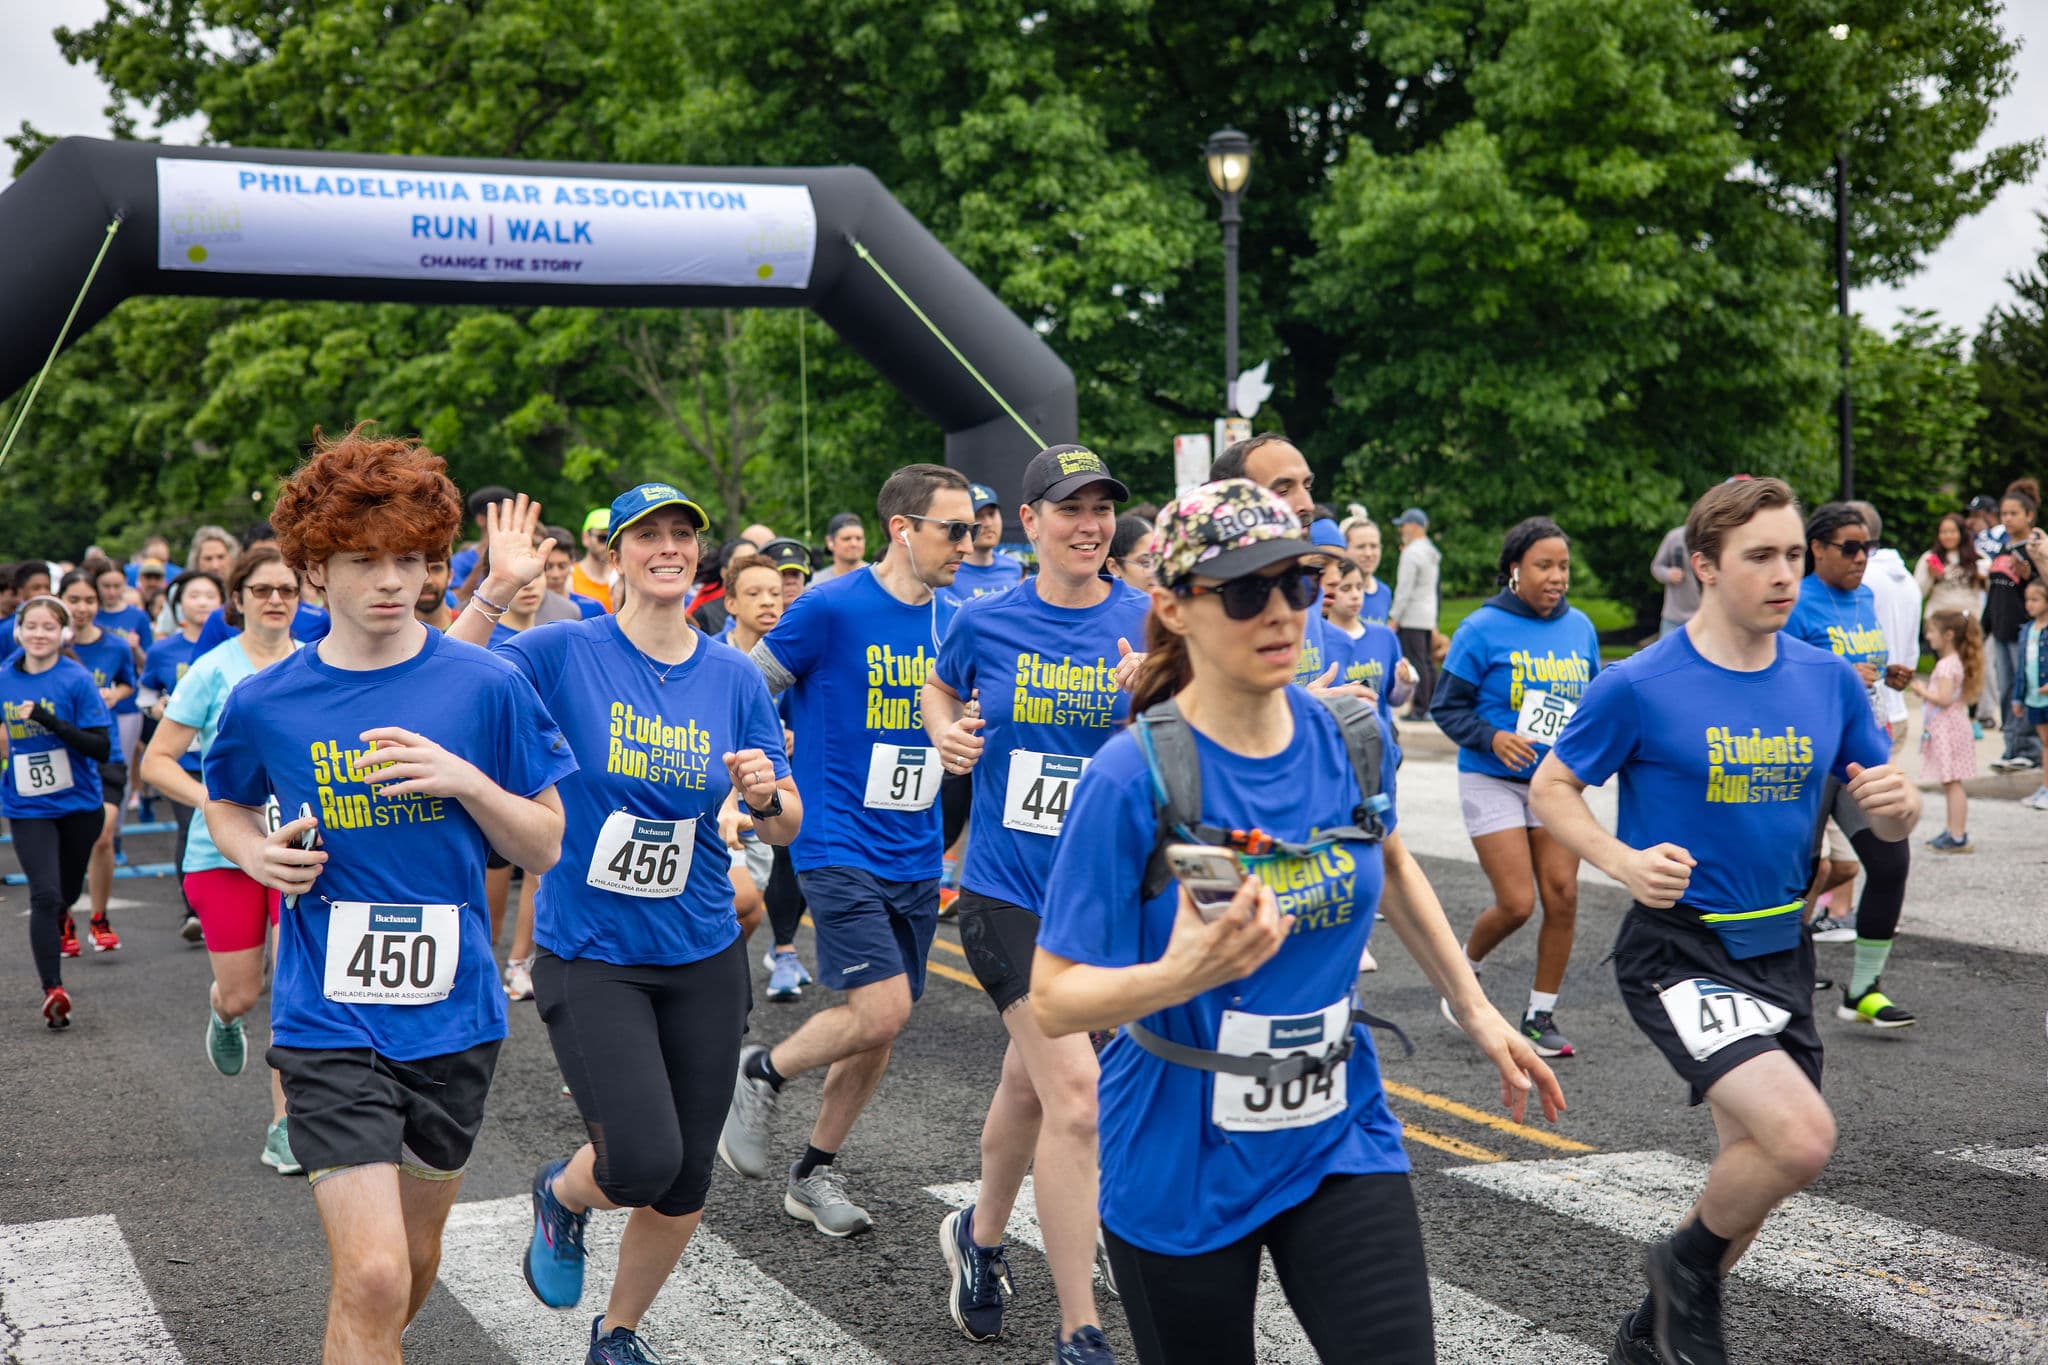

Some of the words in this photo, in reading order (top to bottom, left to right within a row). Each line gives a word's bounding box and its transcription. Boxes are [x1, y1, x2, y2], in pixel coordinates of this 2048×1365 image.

[239, 170, 470, 200] PHILADELPHIA
[481, 183, 542, 204] BAR
[555, 186, 747, 210] ASSOCIATION
[411, 214, 477, 240] RUN
[507, 218, 593, 245] WALK
[420, 254, 488, 271] CHANGE
[494, 257, 525, 271] THE
[530, 258, 583, 273] STORY
[1016, 653, 1118, 693] Students
[866, 688, 910, 730] Run
[1012, 687, 1054, 725] Run
[1056, 692, 1117, 711] PHILLY
[610, 701, 711, 755] Students
[1054, 709, 1112, 728] STYLE
[607, 736, 648, 779] Run
[651, 747, 710, 772] PHILLY
[1706, 726, 1814, 764] Students
[30, 764, 56, 788] 93
[649, 765, 707, 791] STYLE
[890, 766, 923, 801] 91
[1705, 765, 1750, 803] Run
[1752, 766, 1813, 783] PHILLY
[318, 785, 373, 830] Run
[1749, 784, 1802, 803] STYLE
[374, 800, 445, 826] STYLE
[638, 826, 670, 837] Buchanan
[608, 840, 680, 886] 456
[594, 878, 635, 892] PHILADELPHIA
[1278, 873, 1357, 915] PHILLY
[375, 914, 417, 923] Buchanan
[1294, 902, 1354, 934] TYLE
[347, 934, 437, 989] 450
[333, 990, 383, 999] PHILADELPHIA
[385, 991, 402, 999] BAR
